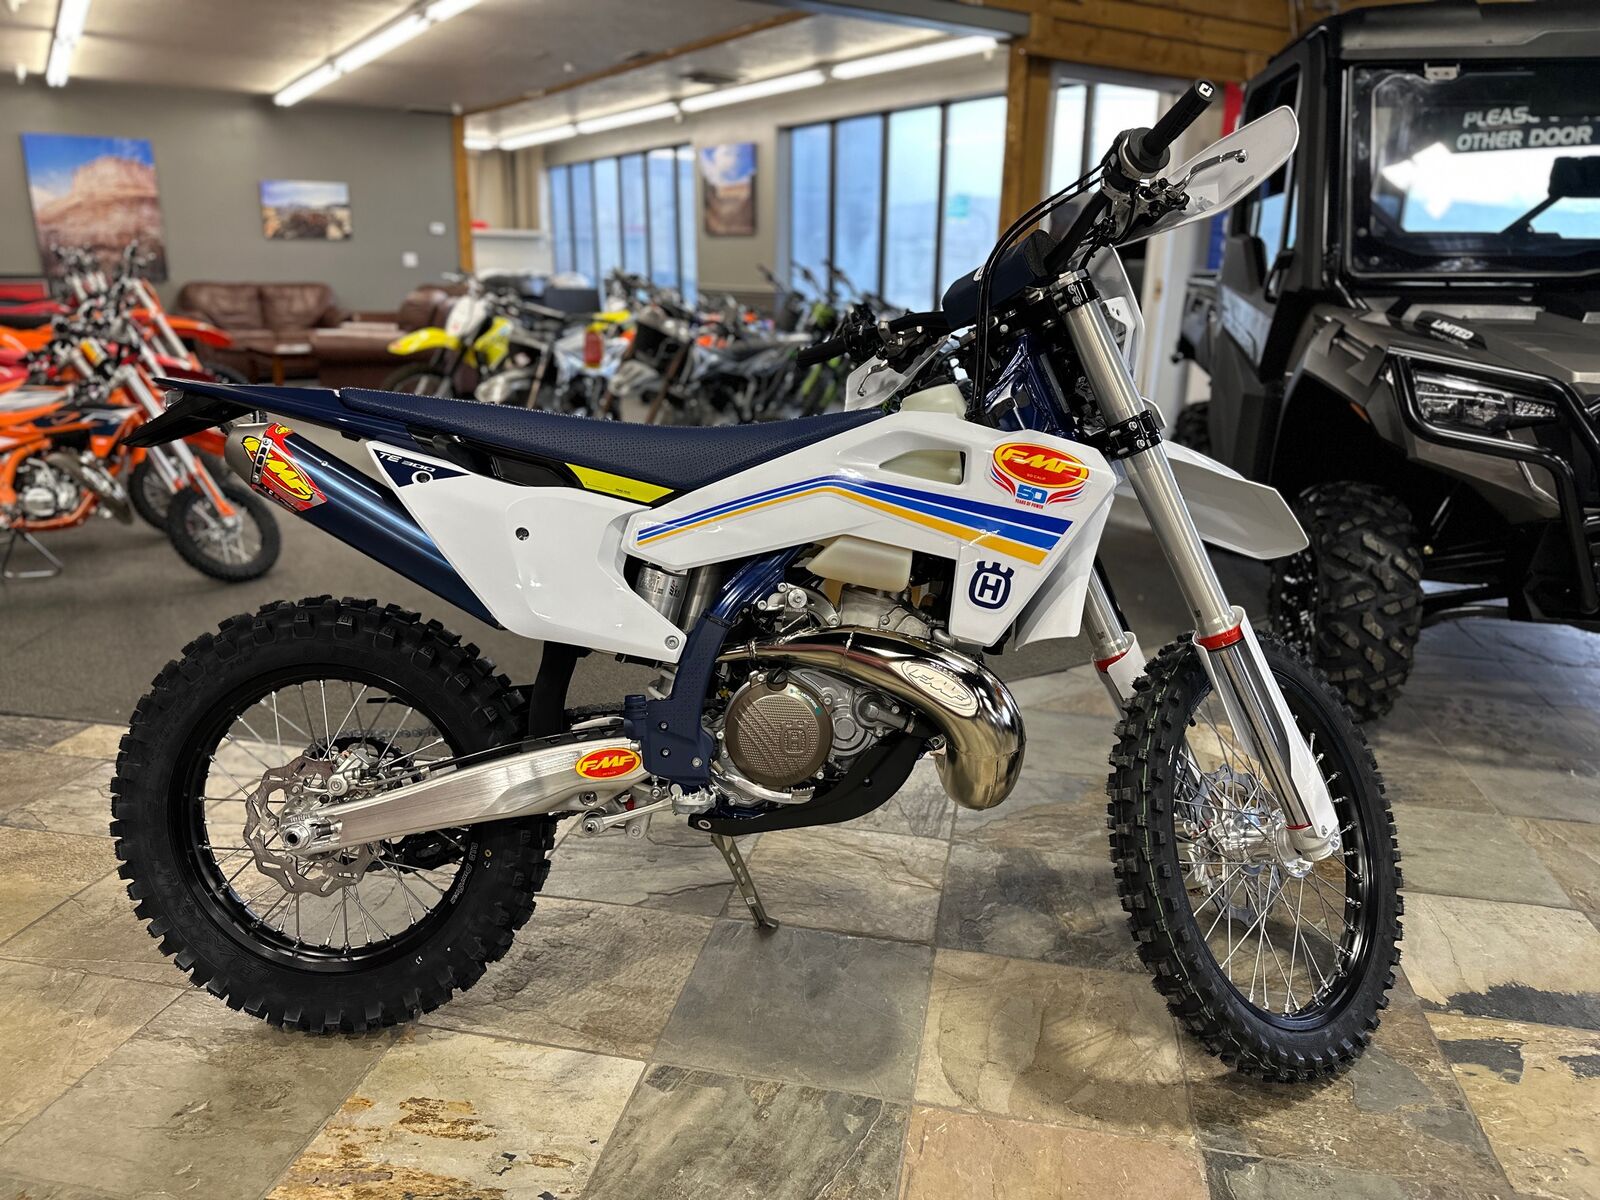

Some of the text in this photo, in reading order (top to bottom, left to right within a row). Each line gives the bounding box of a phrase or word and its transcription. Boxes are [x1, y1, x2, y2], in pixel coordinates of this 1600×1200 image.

[1456, 125, 1593, 151] OTHER DOOR
[379, 452, 436, 473] TE 300
[1001, 448, 1080, 475] FMF
[1016, 484, 1048, 504] 50
[908, 668, 969, 702] FMF
[581, 754, 635, 772] FMF
